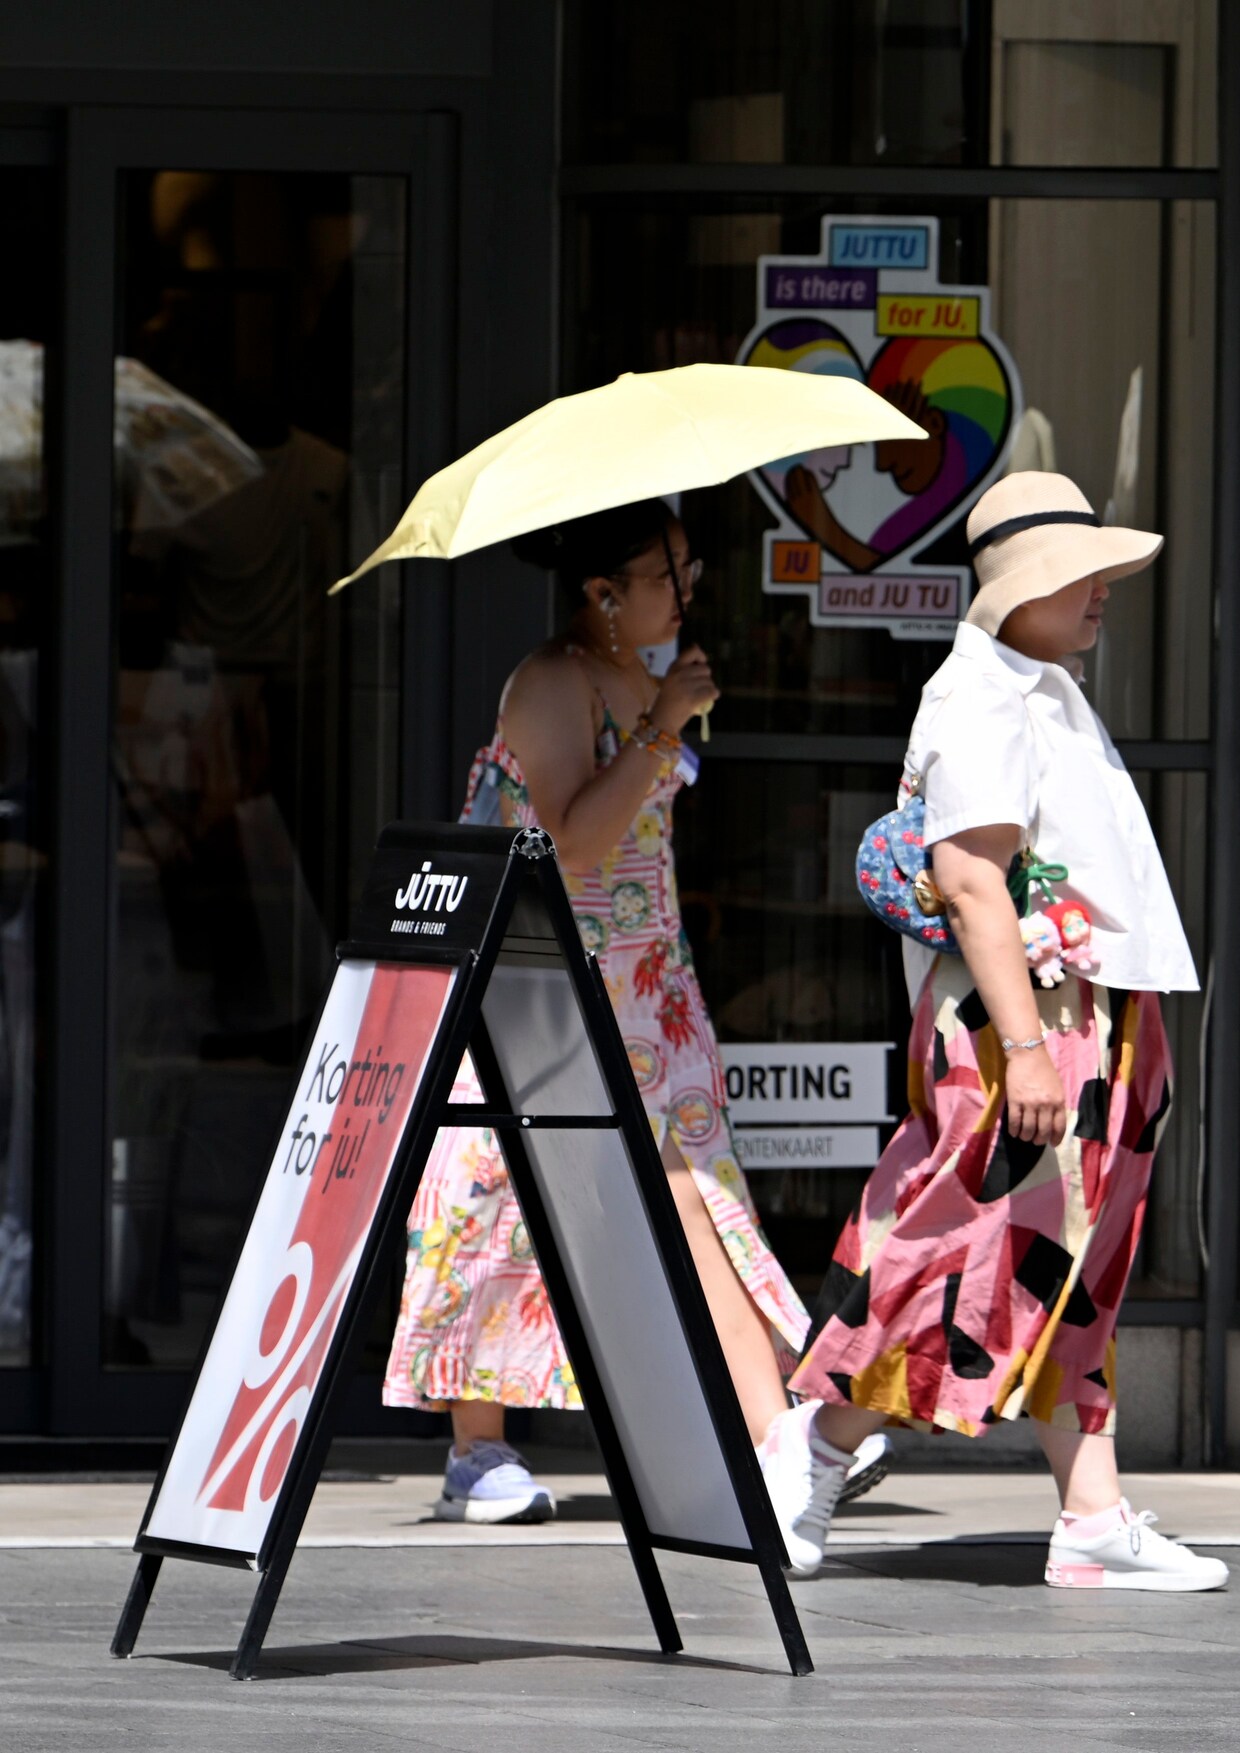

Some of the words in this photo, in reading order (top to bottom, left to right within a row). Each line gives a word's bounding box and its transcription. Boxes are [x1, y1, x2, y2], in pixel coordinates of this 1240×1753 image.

[841, 235, 917, 259] JUTTU
[776, 275, 796, 300] is
[801, 275, 867, 301] there
[887, 303, 927, 327] for
[784, 551, 811, 574] JU
[828, 583, 875, 608] and
[880, 584, 911, 609] JU
[917, 586, 950, 609] TU
[390, 919, 415, 933] BRANDS
[420, 921, 447, 935] FRIENDS
[305, 1042, 406, 1125] Korting
[726, 1065, 851, 1100] ORTING
[283, 1113, 333, 1176] for
[322, 1117, 371, 1195] ju!
[734, 1136, 833, 1159] ENTENKAART
